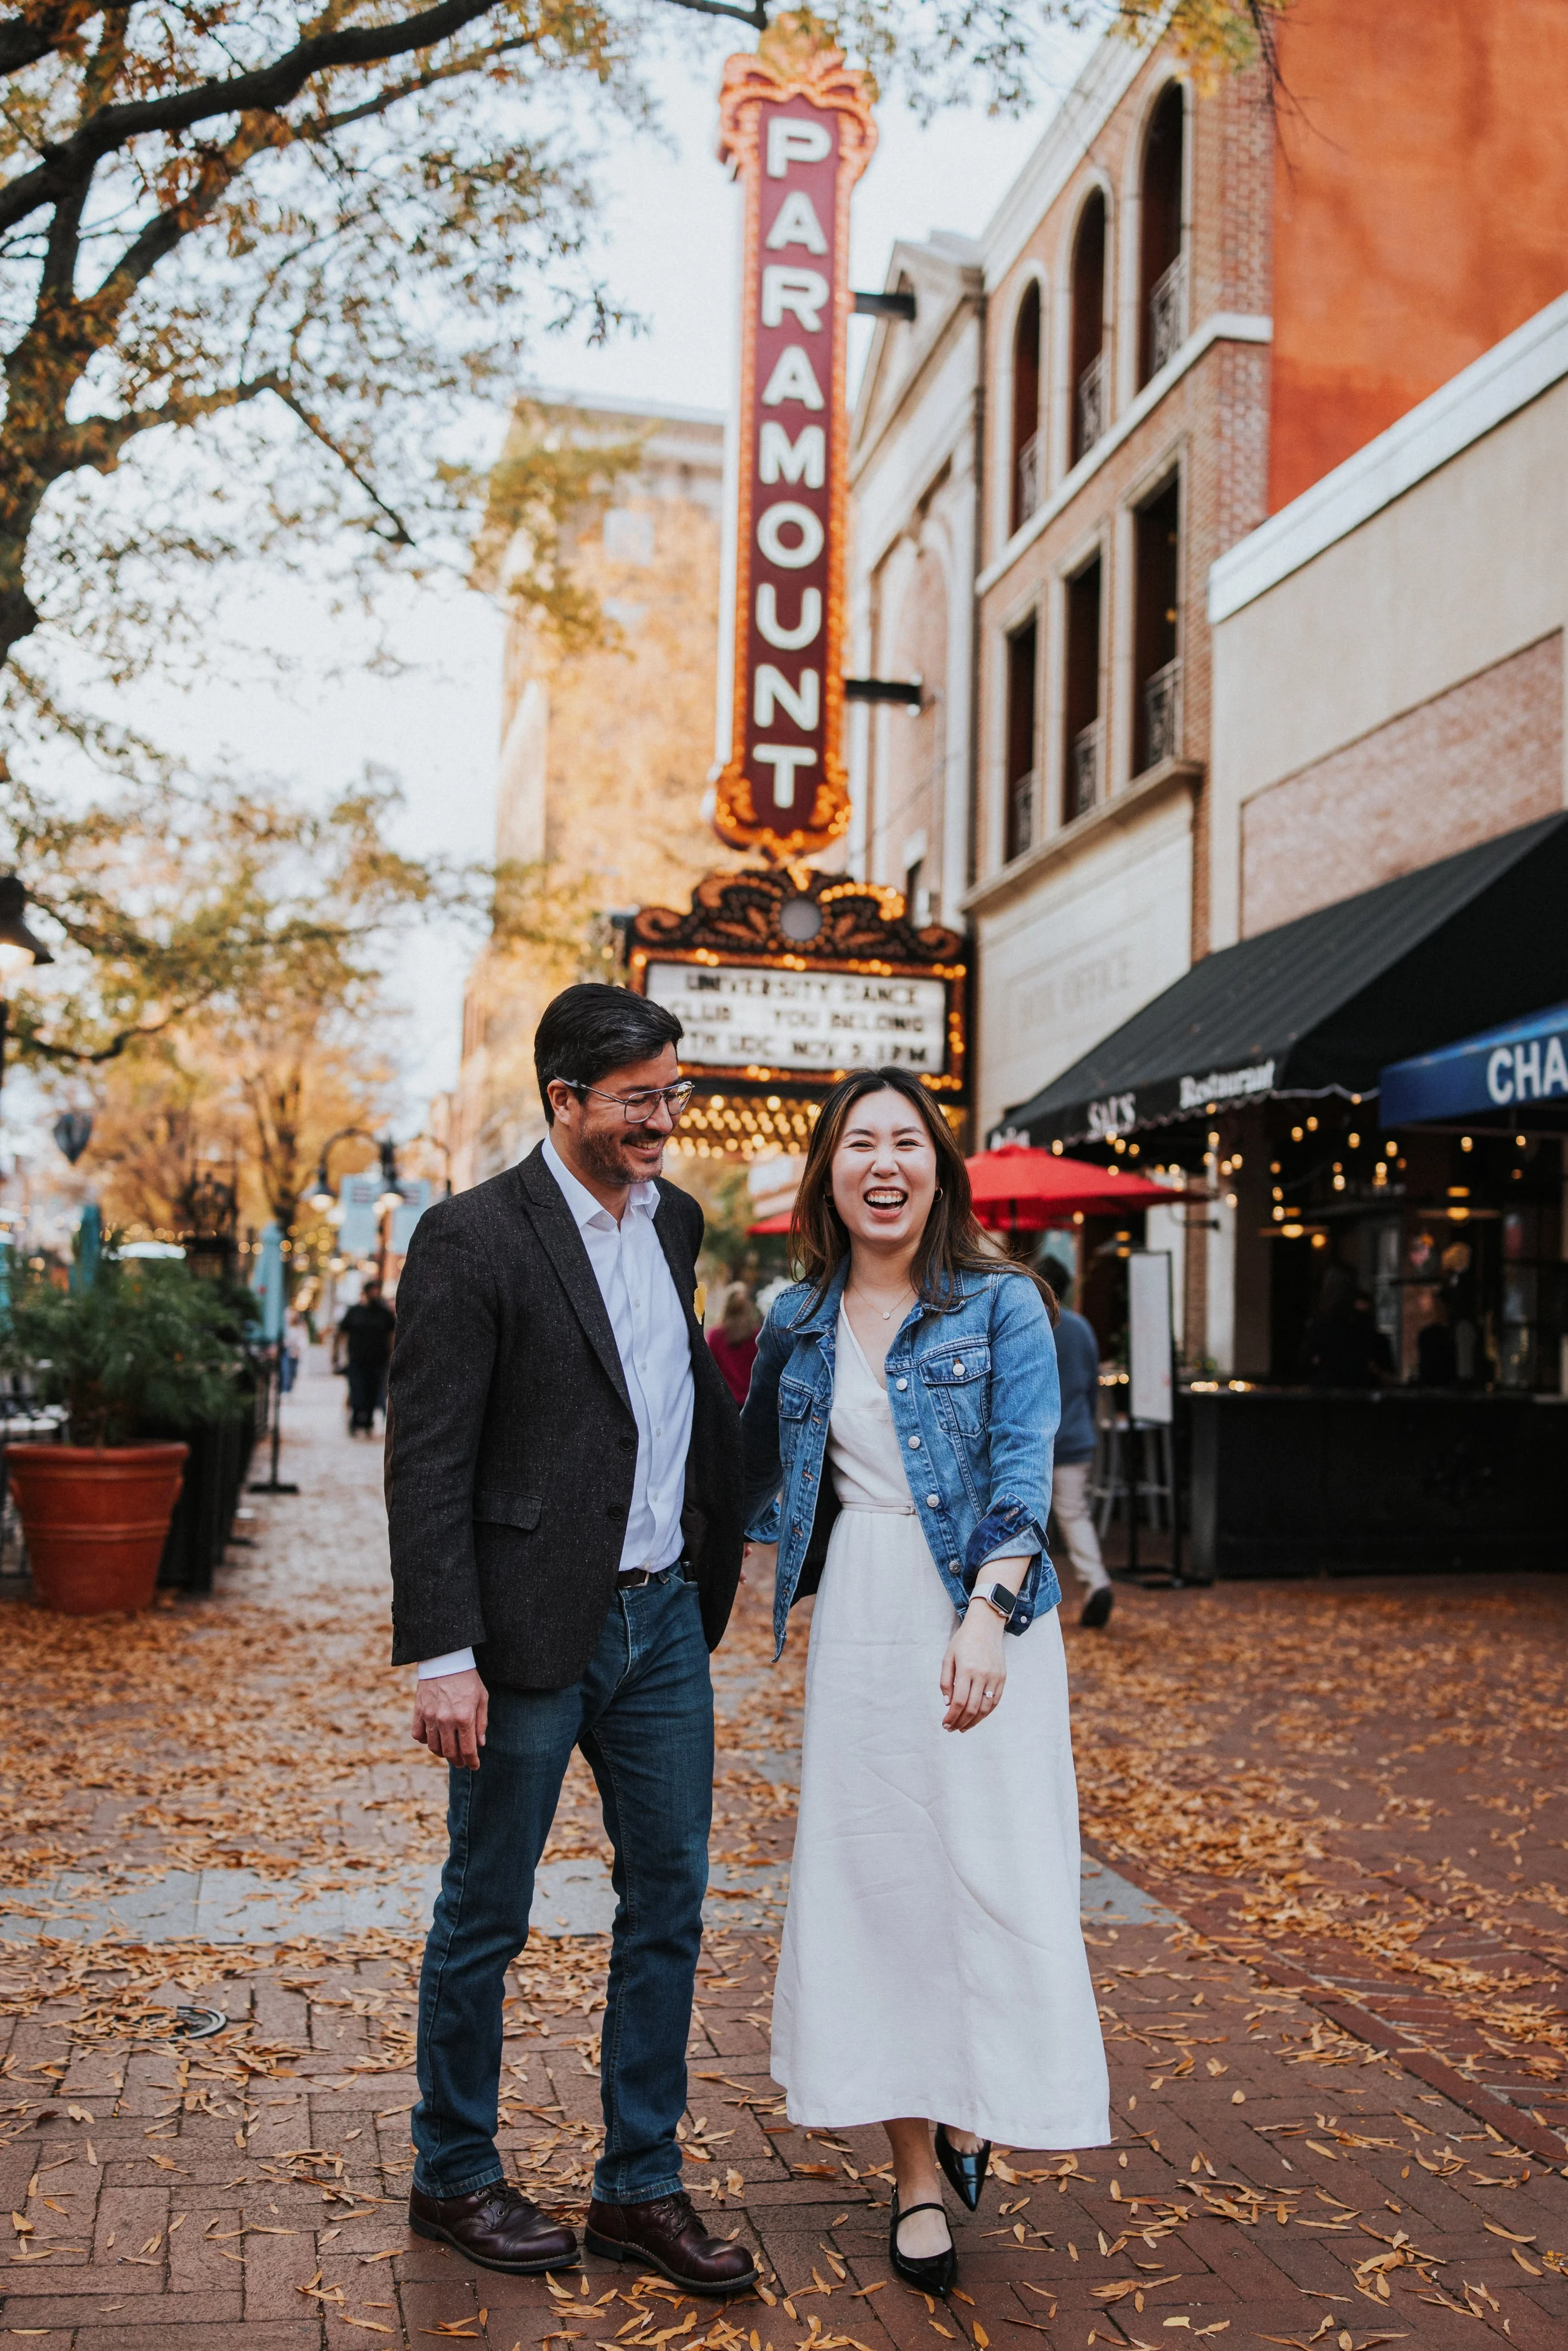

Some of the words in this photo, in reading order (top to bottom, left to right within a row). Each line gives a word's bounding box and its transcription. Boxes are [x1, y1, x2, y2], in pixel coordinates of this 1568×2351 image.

[753, 117, 832, 809] PARAMOUNT
[686, 974, 830, 1002] UNIVERSITY
[842, 981, 919, 1007] DANCE
[774, 1008, 820, 1028] YOU
[830, 1011, 925, 1033] BELONG
[1179, 1058, 1275, 1109] Restaurant
[1486, 1036, 1568, 1104] CHA
